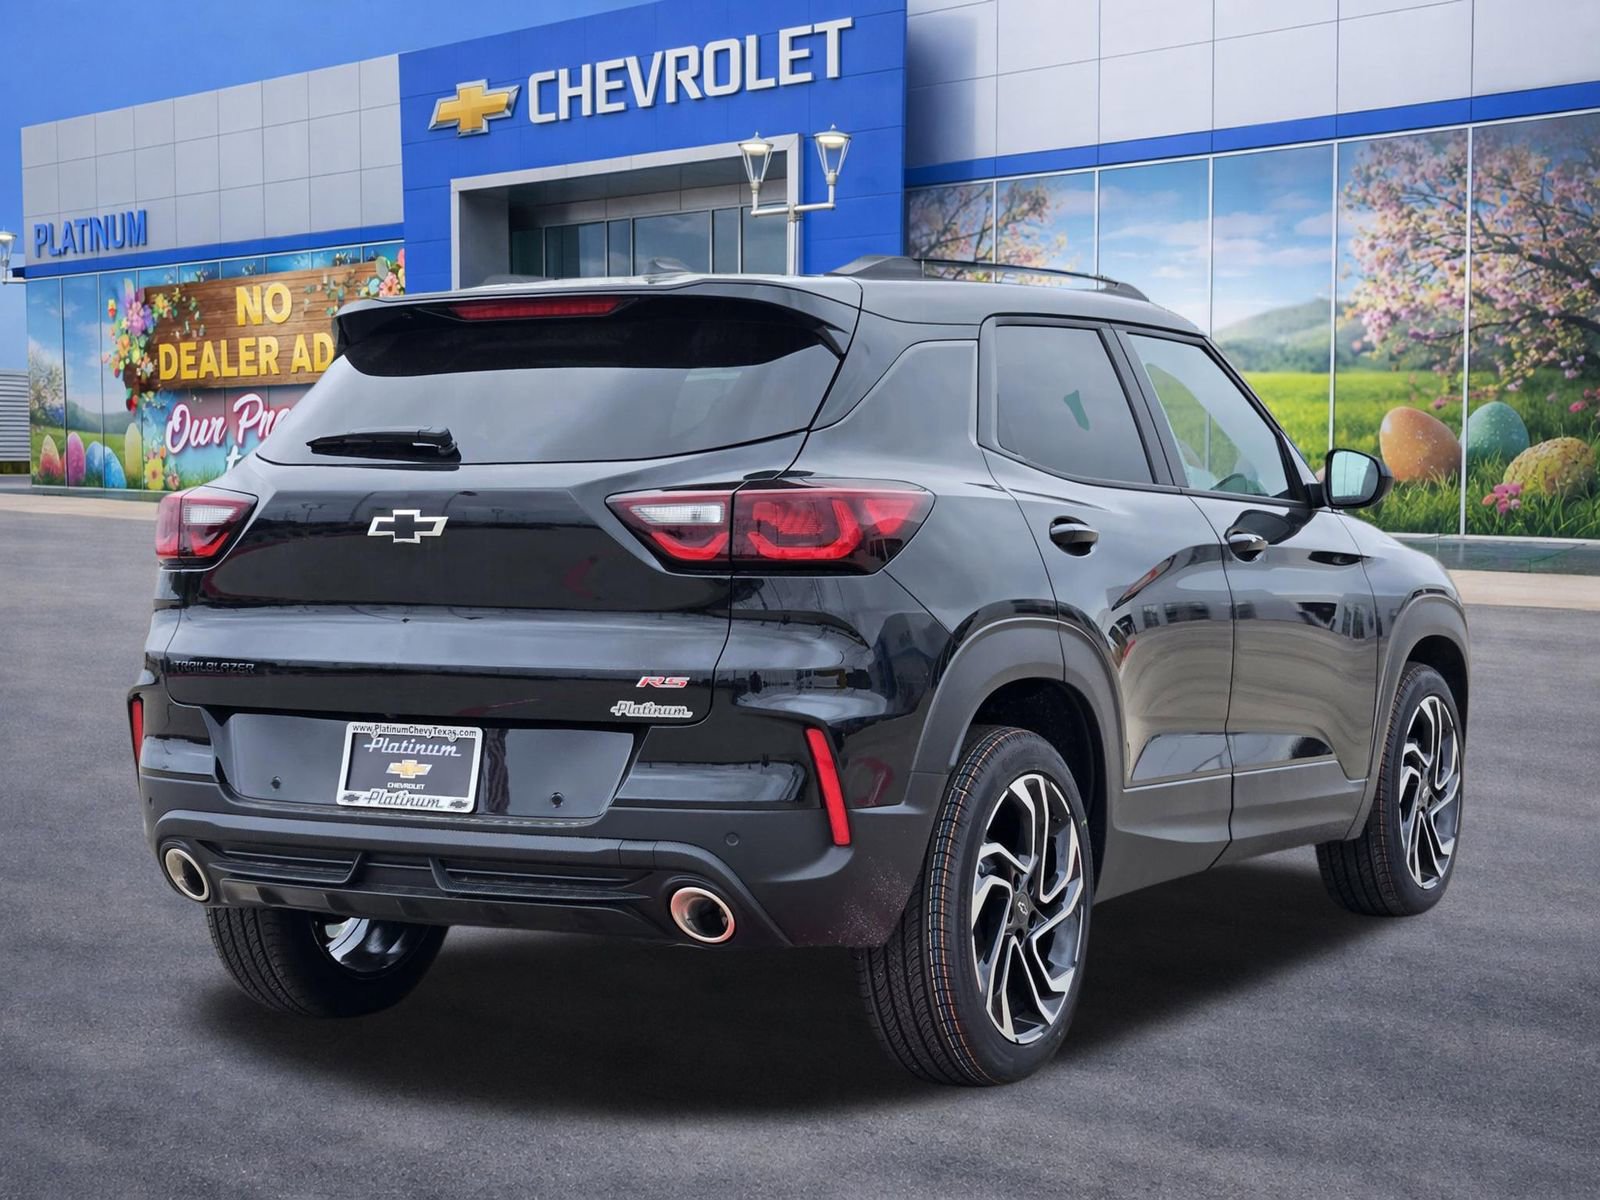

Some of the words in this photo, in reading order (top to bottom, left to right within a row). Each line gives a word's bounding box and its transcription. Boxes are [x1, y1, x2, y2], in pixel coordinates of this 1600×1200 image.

[528, 16, 853, 125] CHEVROLET
[34, 209, 147, 258] PLATINUM
[236, 282, 293, 326] NO
[158, 335, 280, 381] DEALER
[290, 332, 335, 374] AD
[165, 403, 228, 454] Our
[174, 661, 255, 673] TRAILBLAZER
[636, 676, 690, 688] RS
[610, 701, 693, 718] Platinum
[352, 724, 477, 737] www.PlatinumChevyTexas.com
[364, 737, 461, 756] Platinum
[387, 782, 425, 790] CHEVROLET
[364, 790, 444, 809] Platinum
